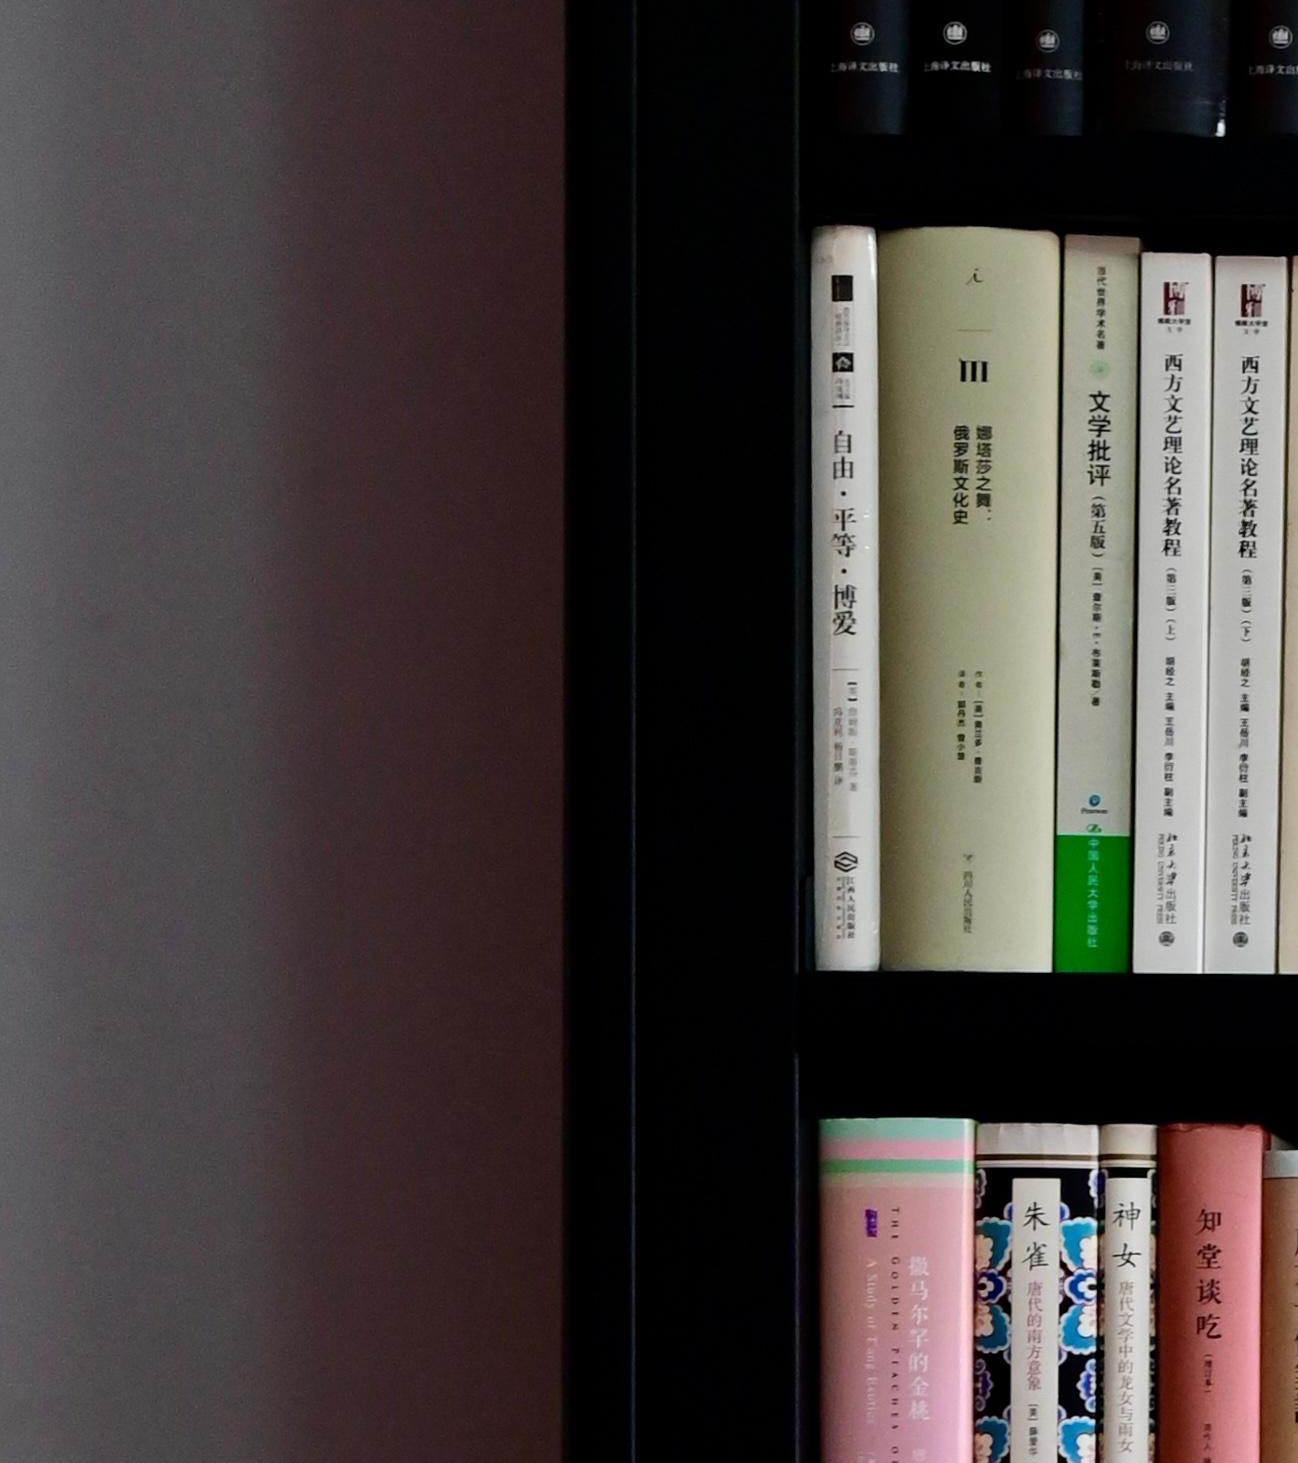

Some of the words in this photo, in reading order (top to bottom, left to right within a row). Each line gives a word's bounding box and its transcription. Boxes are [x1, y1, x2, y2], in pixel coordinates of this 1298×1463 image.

[953, 424, 970, 525] 俄罗斯文化史
[1087, 390, 1111, 487] 文学批评
[1163, 353, 1183, 557] 西方文艺理论名著教程
[1023, 1201, 1049, 1271] 朱雀
[1113, 1201, 1141, 1268] 神女
[1196, 1208, 1222, 1340] 知堂谈吃
[1026, 1280, 1043, 1392] 唐代的南方意象
